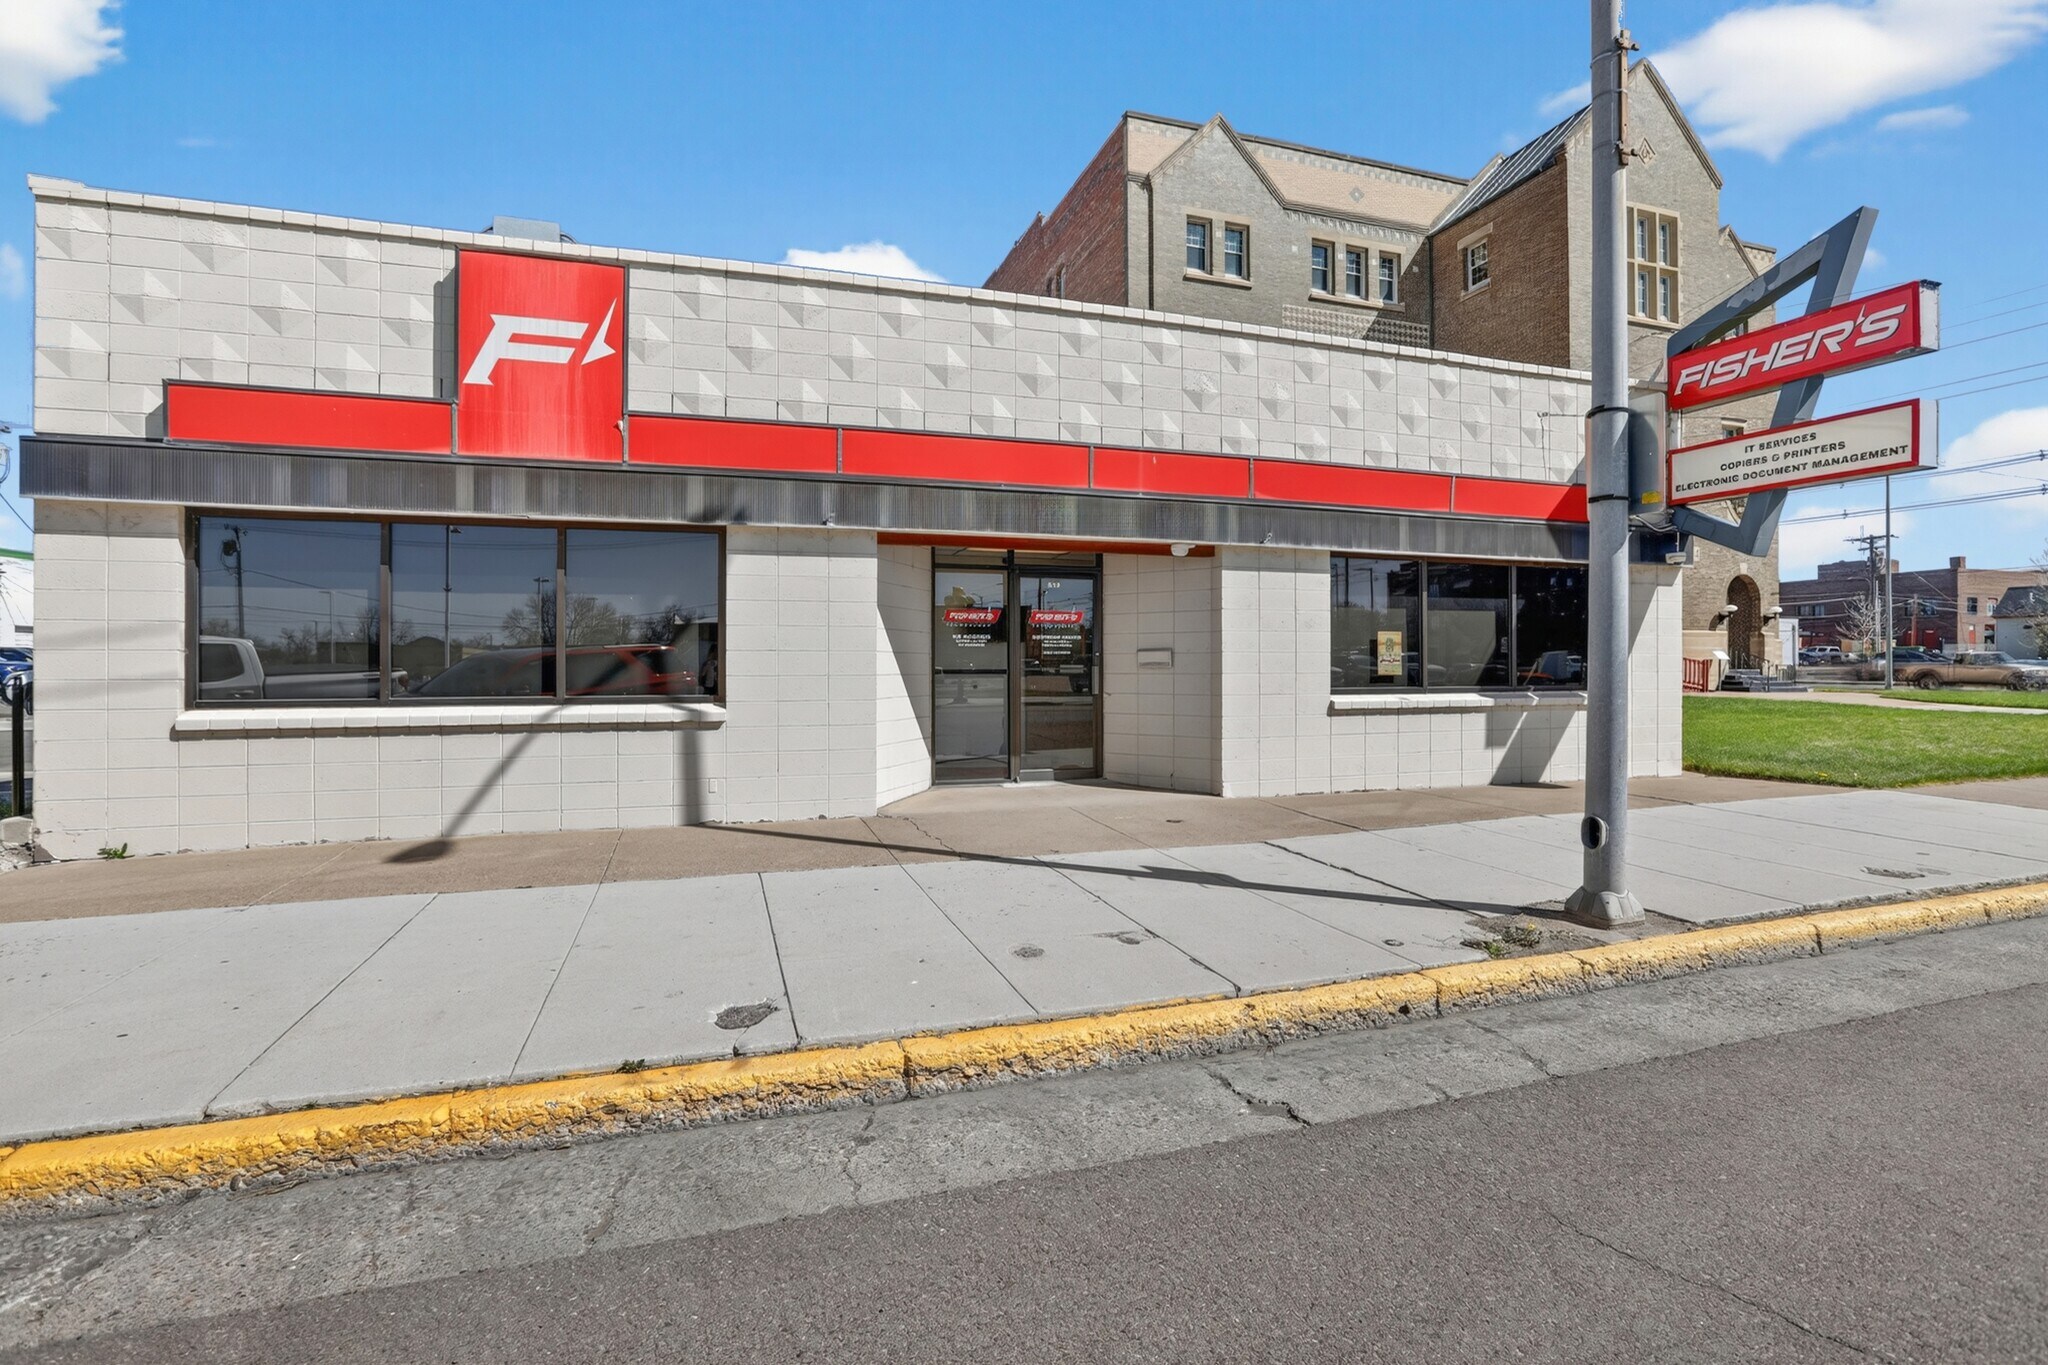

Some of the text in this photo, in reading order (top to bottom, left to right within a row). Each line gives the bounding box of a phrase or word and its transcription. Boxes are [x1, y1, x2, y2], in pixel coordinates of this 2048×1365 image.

[1674, 304, 1907, 396] FISHER'S
[1720, 456, 1768, 472] COPIERS
[1783, 441, 1846, 461] PRINTERS
[1744, 432, 1817, 453] IT SERVICES
[1675, 444, 1909, 493] ELECTRONIC DOCUMENT MANAGEMENT
